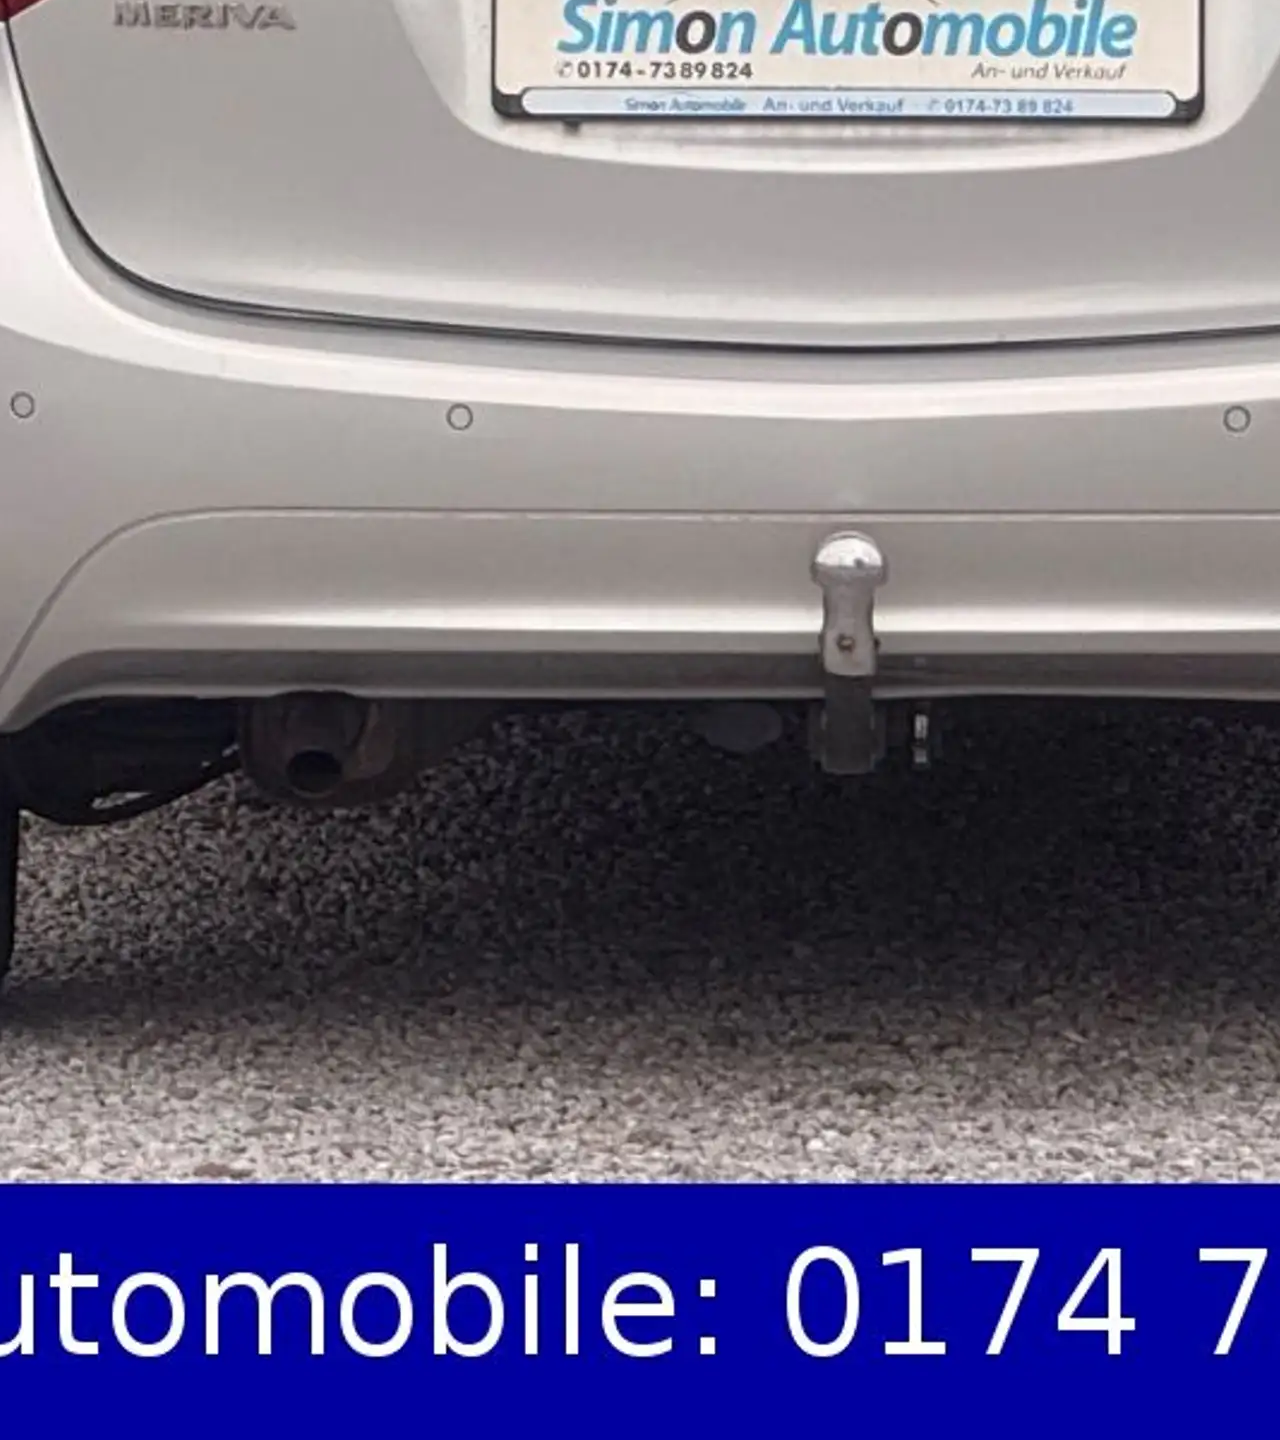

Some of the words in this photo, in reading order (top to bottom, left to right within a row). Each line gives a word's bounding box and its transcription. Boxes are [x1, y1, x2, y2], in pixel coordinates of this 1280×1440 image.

[114, 1, 297, 31] MERIVA
[1011, 63, 1049, 79] und
[1053, 63, 1127, 80] Verkauf
[799, 96, 831, 111] und
[837, 97, 904, 112] Verkauf
